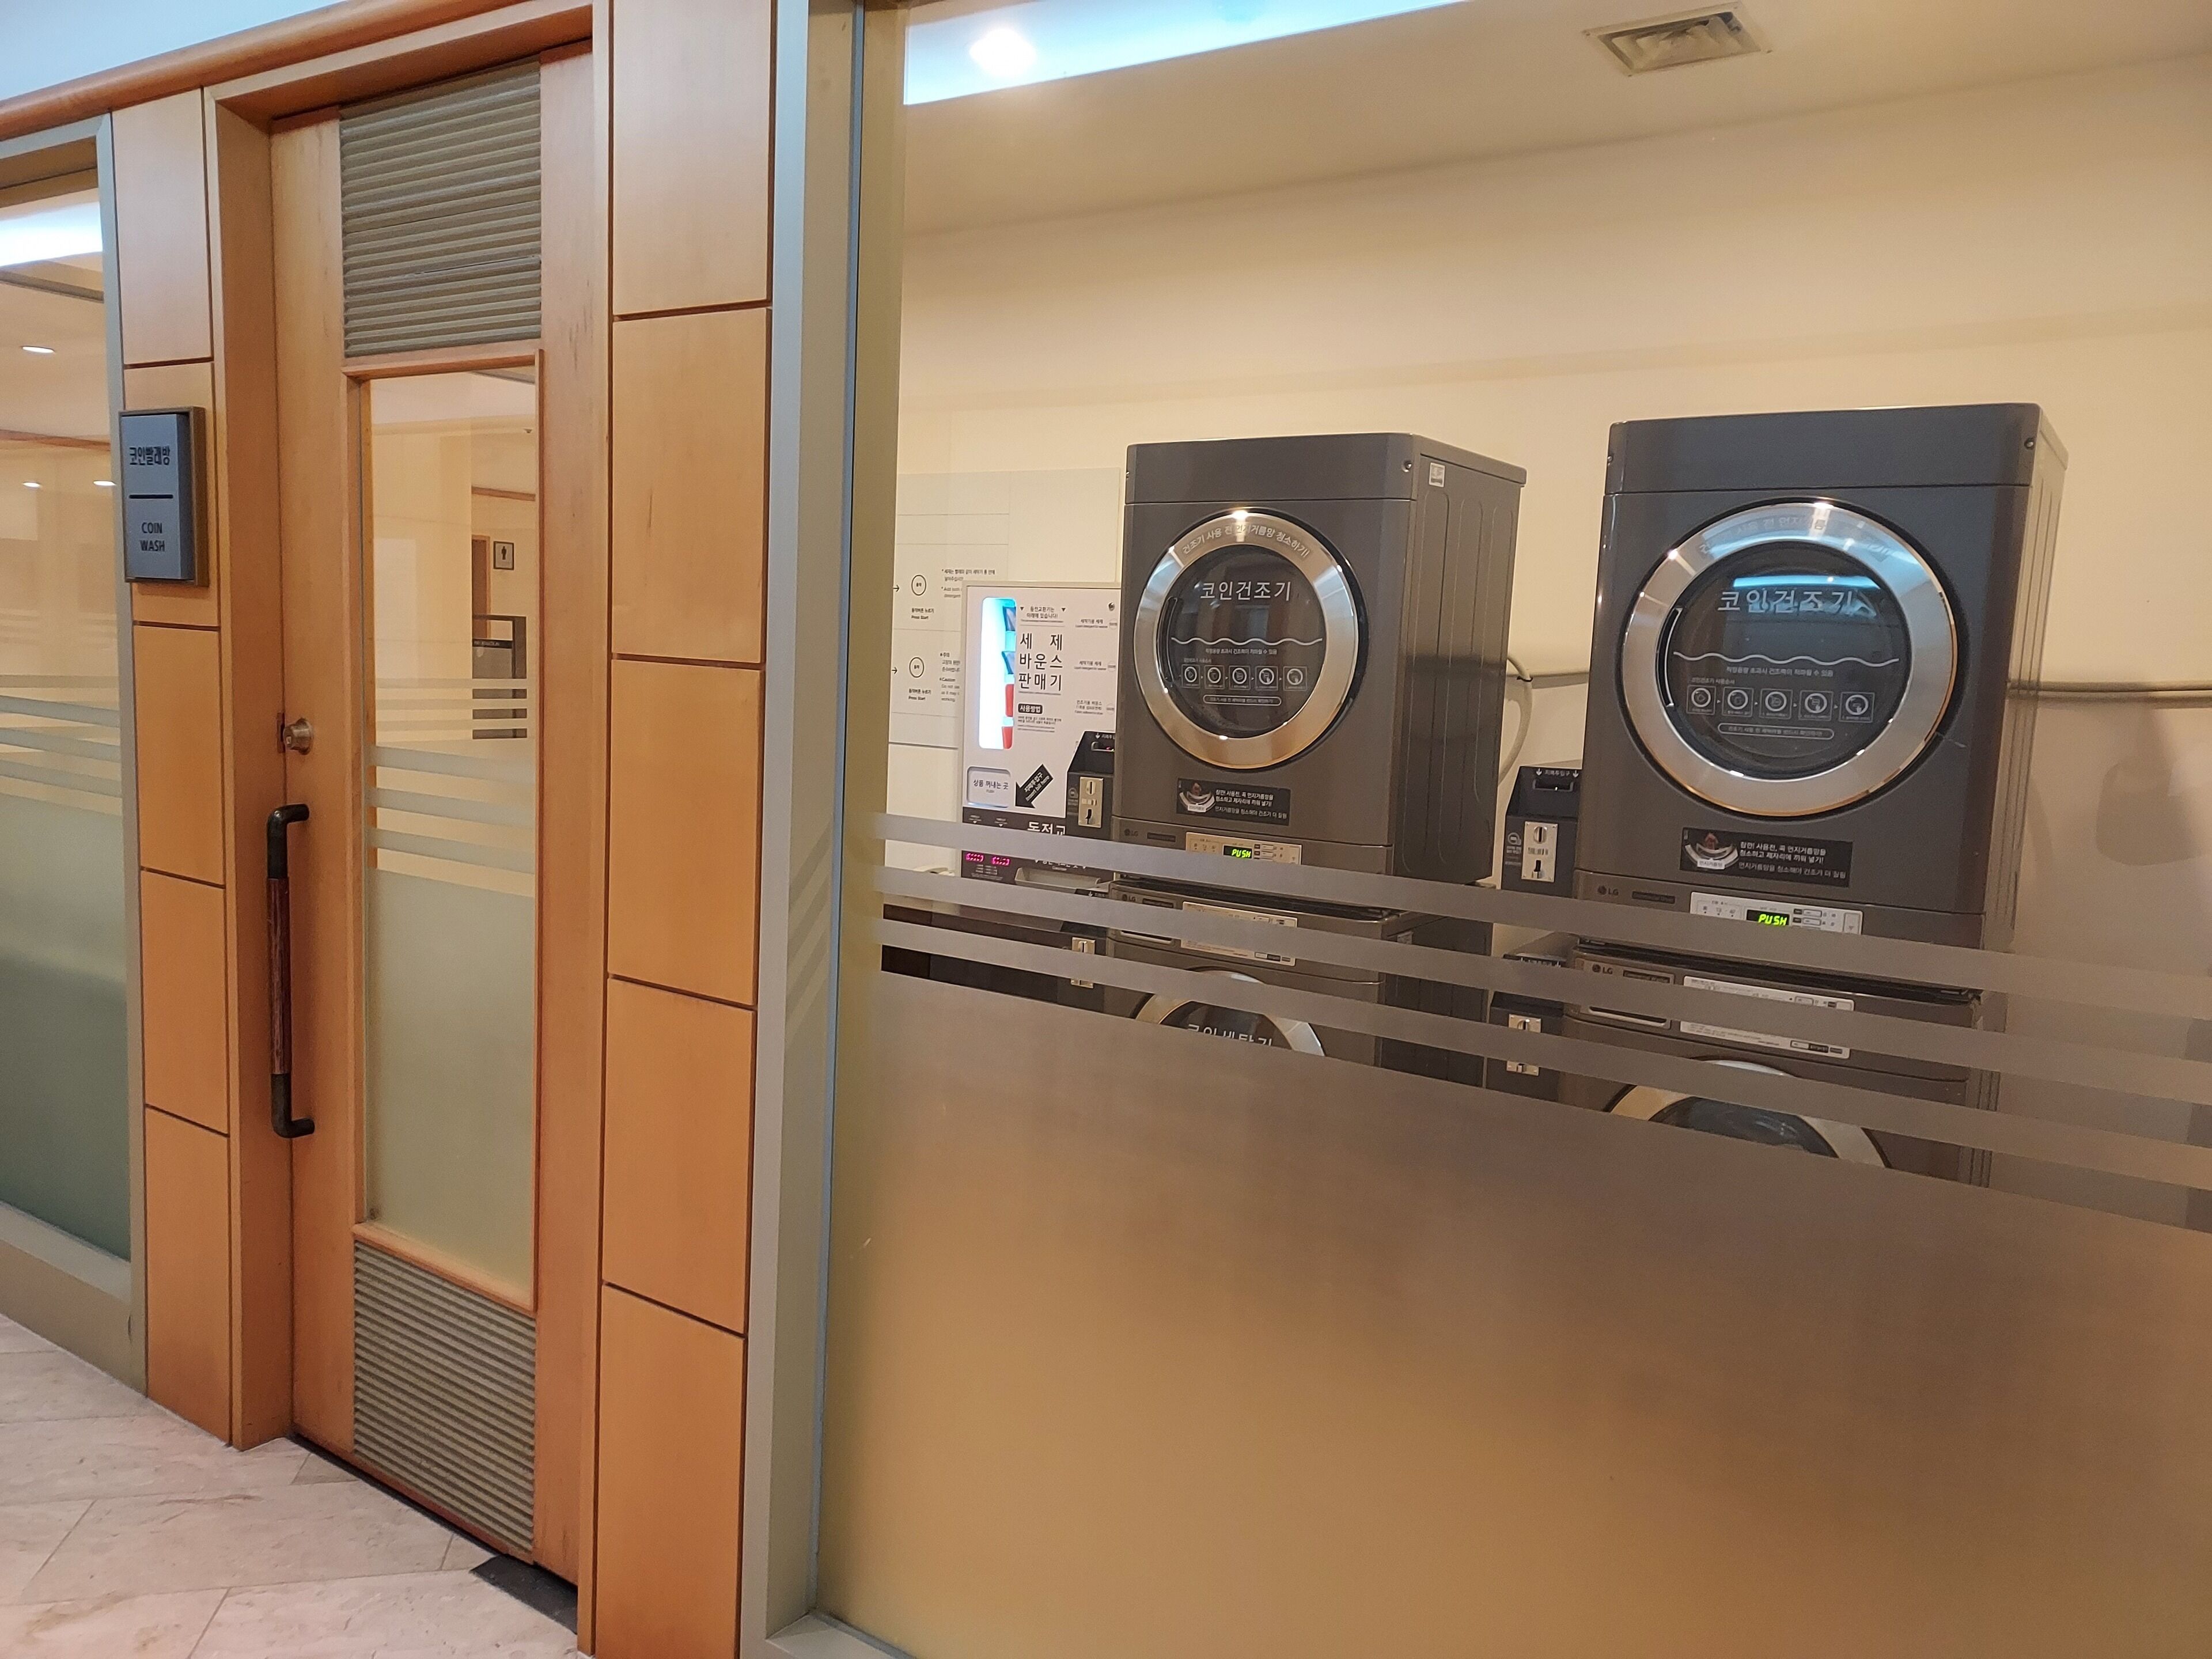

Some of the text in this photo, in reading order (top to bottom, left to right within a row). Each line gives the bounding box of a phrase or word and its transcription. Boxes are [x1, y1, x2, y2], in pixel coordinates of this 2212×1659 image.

[129, 446, 171, 465] 코인빨래방
[141, 522, 162, 534] COIN
[1183, 534, 1205, 554] 건조기
[1207, 528, 1222, 540] 사용
[1225, 525, 1233, 535] 전
[139, 540, 165, 552] WASH
[1200, 581, 1291, 601] 코인건조기
[1718, 589, 1853, 613] 코인건조기
[1019, 653, 1063, 670] 바운스
[1018, 673, 1062, 691] 판매기
[1020, 704, 1041, 713] 사용방법
[985, 781, 1001, 789] 꺼내는
[1232, 849, 1252, 858] PUSH
[1608, 888, 1619, 896] LG
[1759, 914, 1787, 926] PUSH
[1603, 967, 1613, 975] LG
